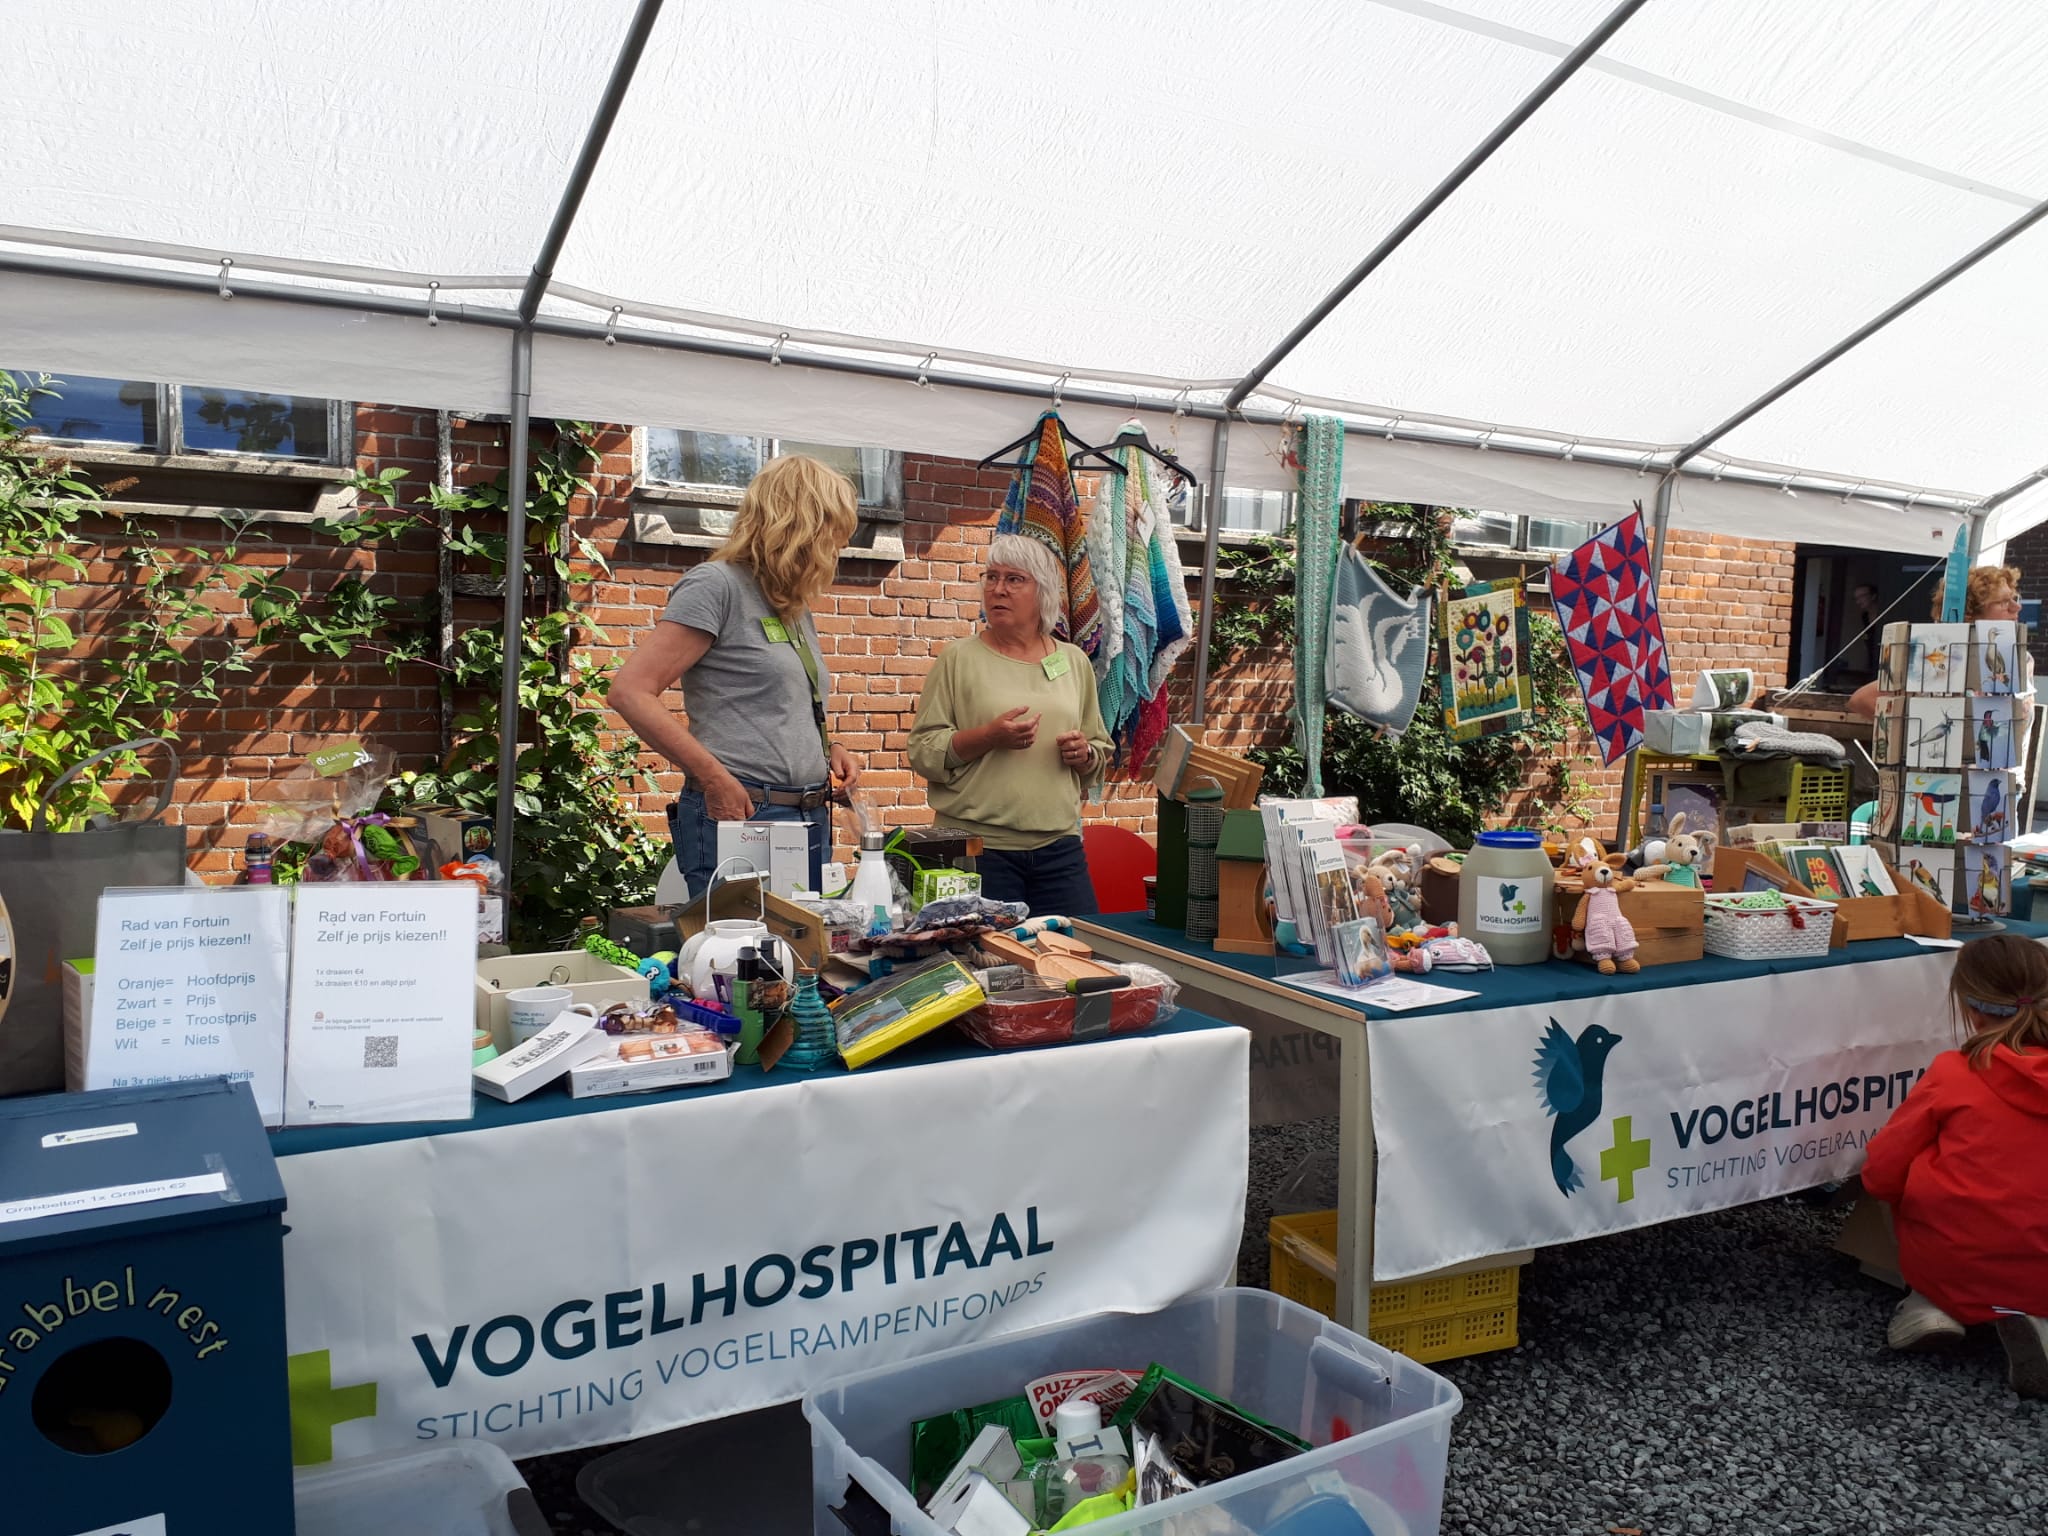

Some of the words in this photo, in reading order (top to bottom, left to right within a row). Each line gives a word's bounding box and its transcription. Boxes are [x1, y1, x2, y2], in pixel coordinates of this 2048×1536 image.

[121, 920, 149, 931] Rad
[154, 920, 178, 930] van
[184, 917, 230, 928] Fortuin
[318, 911, 347, 923] Rad
[351, 912, 375, 922] van
[380, 911, 426, 922] Fortuin
[120, 938, 147, 951] Zelf
[149, 938, 163, 952] je
[167, 937, 194, 951] prijs
[199, 933, 251, 947] kiezen!!
[317, 930, 344, 942] Zelf
[346, 930, 359, 944] je
[363, 930, 391, 944] prijs
[395, 930, 447, 942] kiezen!!
[187, 972, 256, 988] Hoofdprijs
[117, 997, 157, 1010] Zwart
[186, 994, 216, 1006] Prijs
[116, 1017, 157, 1031] Beige
[186, 1011, 257, 1026] Troostprijs
[115, 1037, 138, 1050] Wit
[184, 1034, 220, 1046] Niets
[112, 1078, 129, 1087] Na
[1667, 1148, 1766, 1188] STICHTING
[1774, 1127, 1883, 1166] VOGELRAM
[411, 1205, 1054, 1389] VOGELHOSPITAAL
[0, 1266, 134, 1391] rabbel
[148, 1287, 228, 1358] nest
[416, 1369, 643, 1440] STICHTING
[656, 1271, 1047, 1385] VOGELRAMPENFONDS
